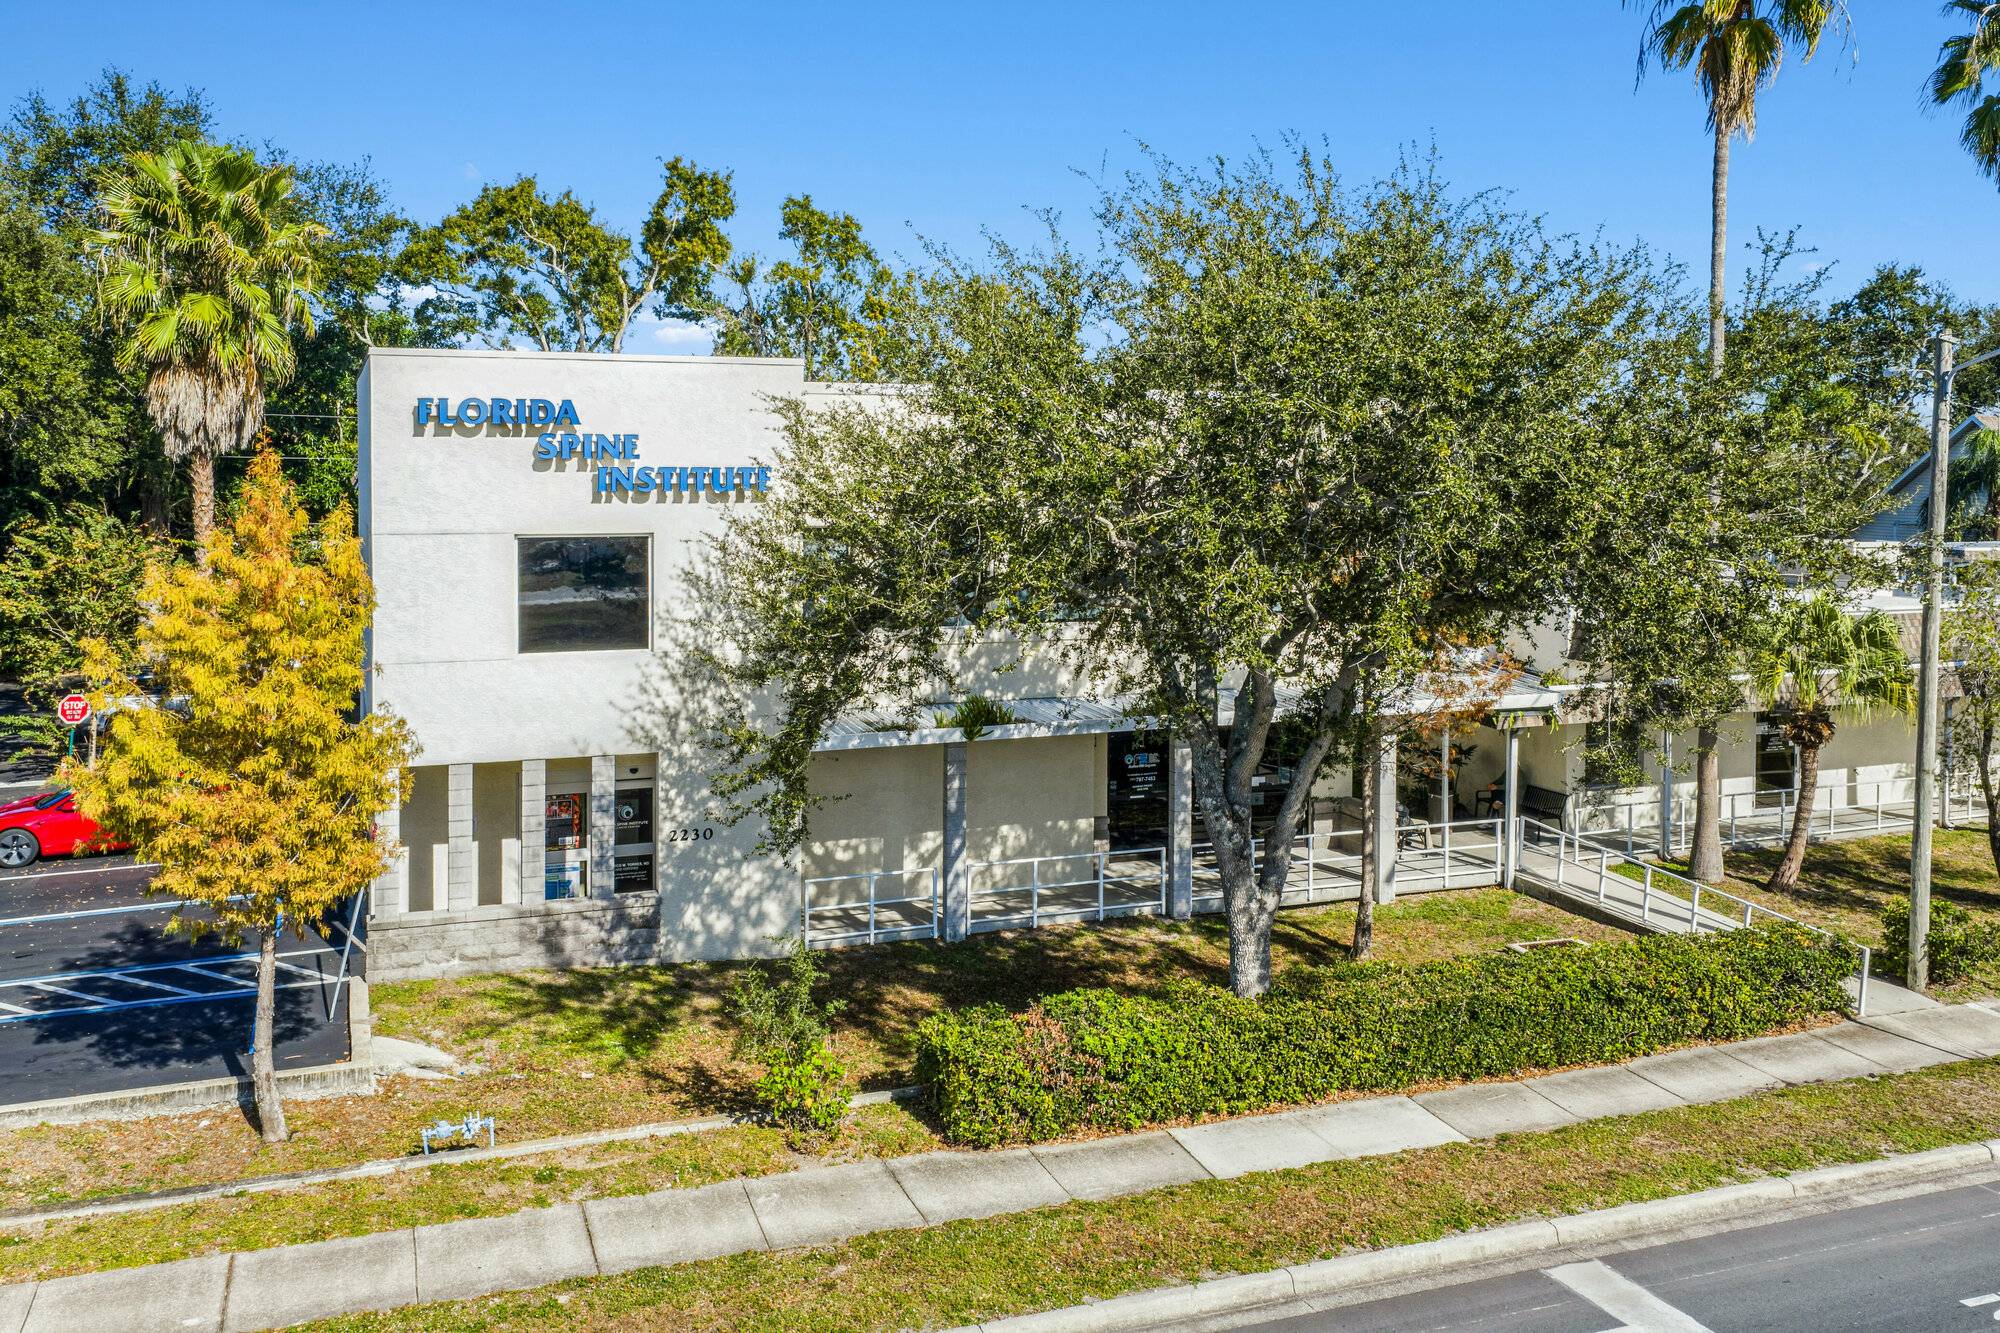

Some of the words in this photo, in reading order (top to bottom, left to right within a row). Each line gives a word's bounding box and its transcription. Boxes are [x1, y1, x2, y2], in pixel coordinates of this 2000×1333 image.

[416, 397, 582, 426] FLORIDA
[537, 432, 641, 460] SPINE
[597, 465, 772, 494] INSTITUTE
[63, 701, 86, 710] STOP
[669, 827, 714, 842] 2230
